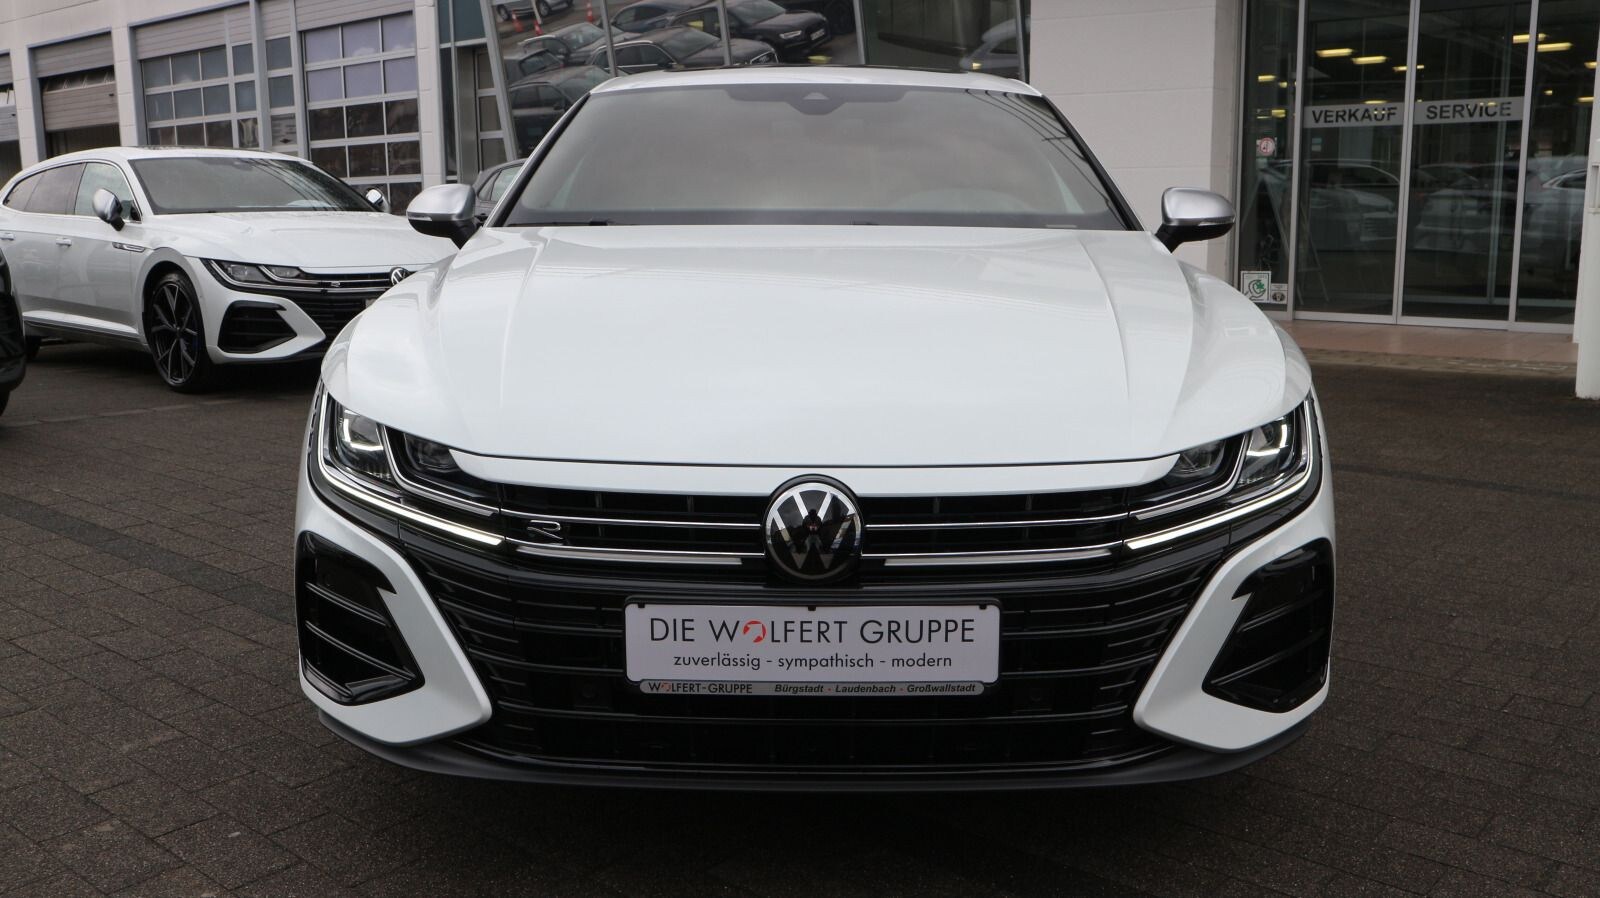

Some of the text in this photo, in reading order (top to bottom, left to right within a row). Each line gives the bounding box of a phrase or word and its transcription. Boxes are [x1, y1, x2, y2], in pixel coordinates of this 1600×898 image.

[1312, 102, 1512, 123] VERKAUF SERVICE
[650, 618, 975, 644] DIE WOLFERT GRUPPE
[673, 651, 761, 670] zuverlässig
[778, 652, 874, 670] sympathisch
[891, 652, 952, 667] modern
[774, 684, 824, 695] Bürgstadt
[835, 684, 896, 693] Laudenbach
[906, 684, 976, 693] Großwallstadt
